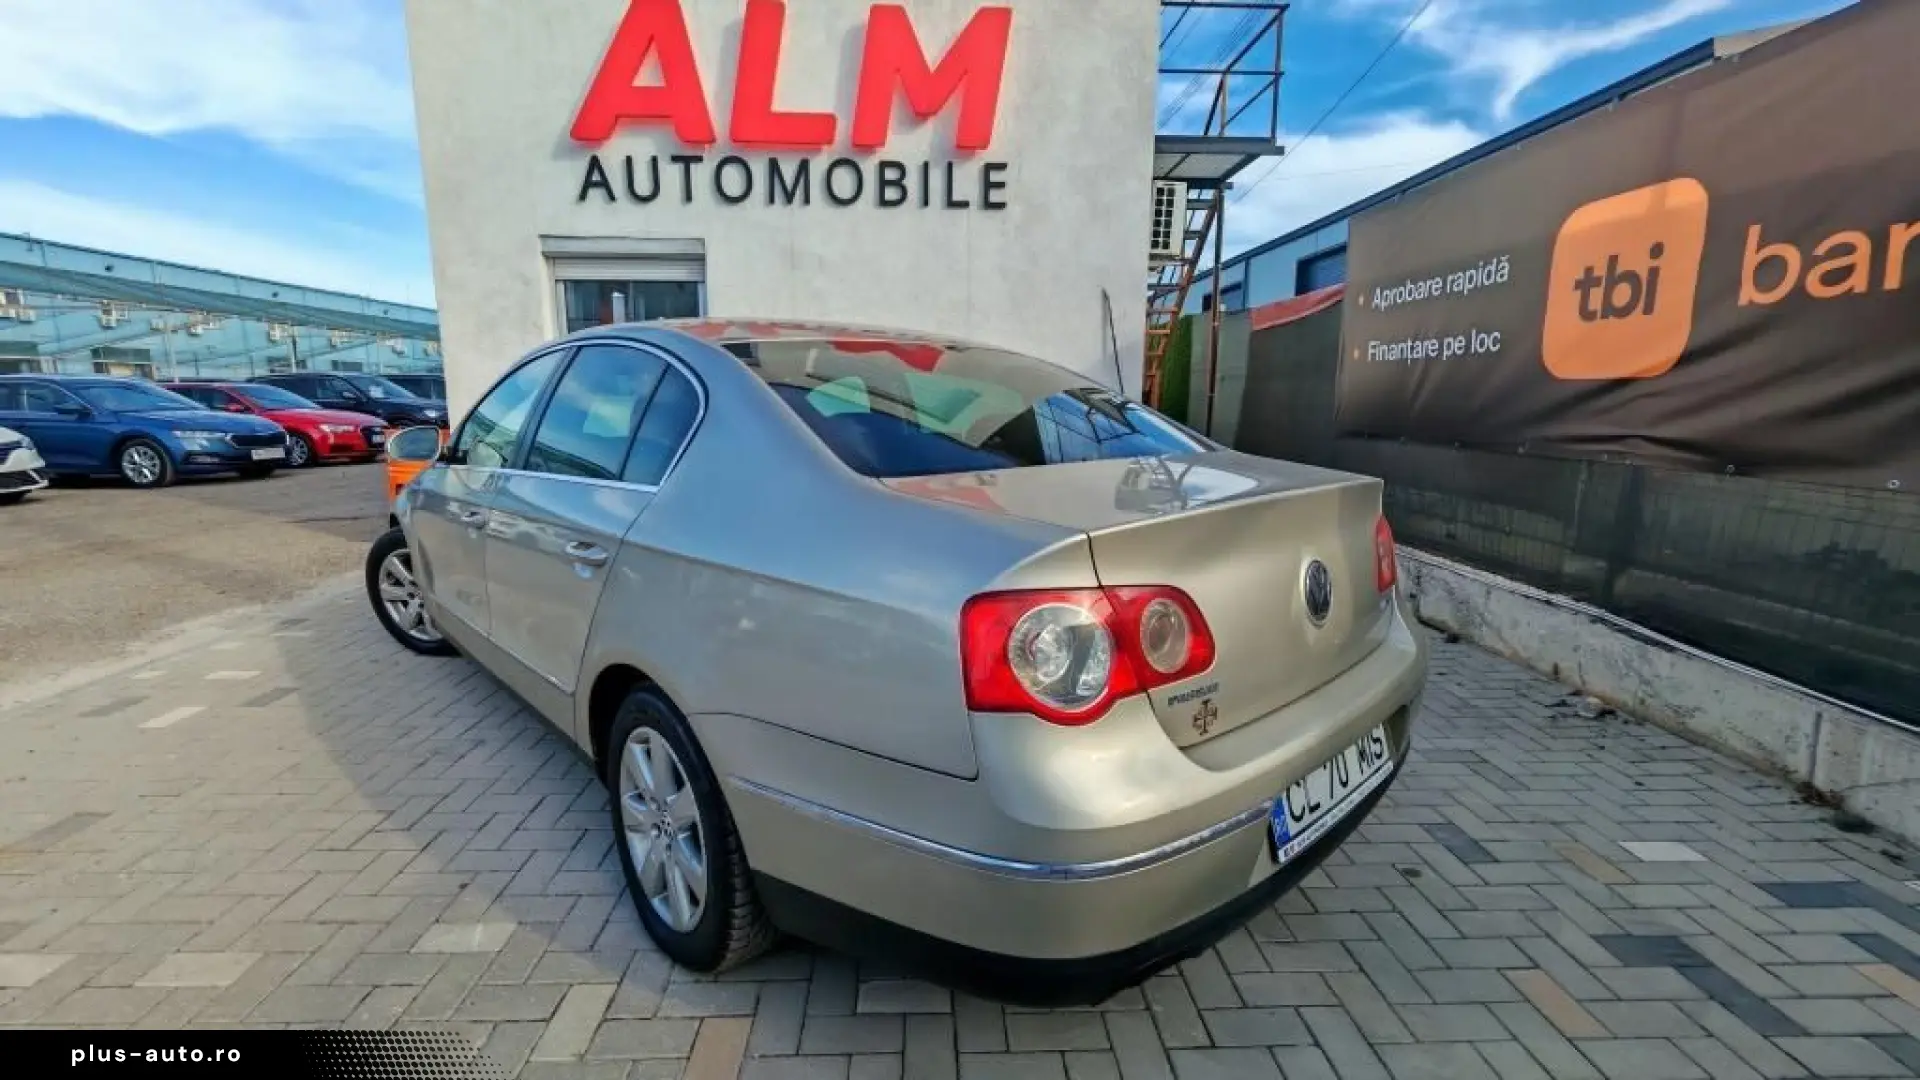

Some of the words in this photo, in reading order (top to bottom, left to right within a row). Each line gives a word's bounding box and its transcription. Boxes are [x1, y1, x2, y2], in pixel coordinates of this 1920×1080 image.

[570, 0, 1013, 150] ALM
[579, 154, 1008, 210] AUTOMOBILE
[1372, 274, 1443, 311] Aprobare
[1446, 254, 1510, 294] rapidă
[1574, 241, 1664, 322] tbi
[1367, 337, 1439, 366] Finanțare
[1443, 334, 1466, 360] pe
[1471, 328, 1501, 354] loc
